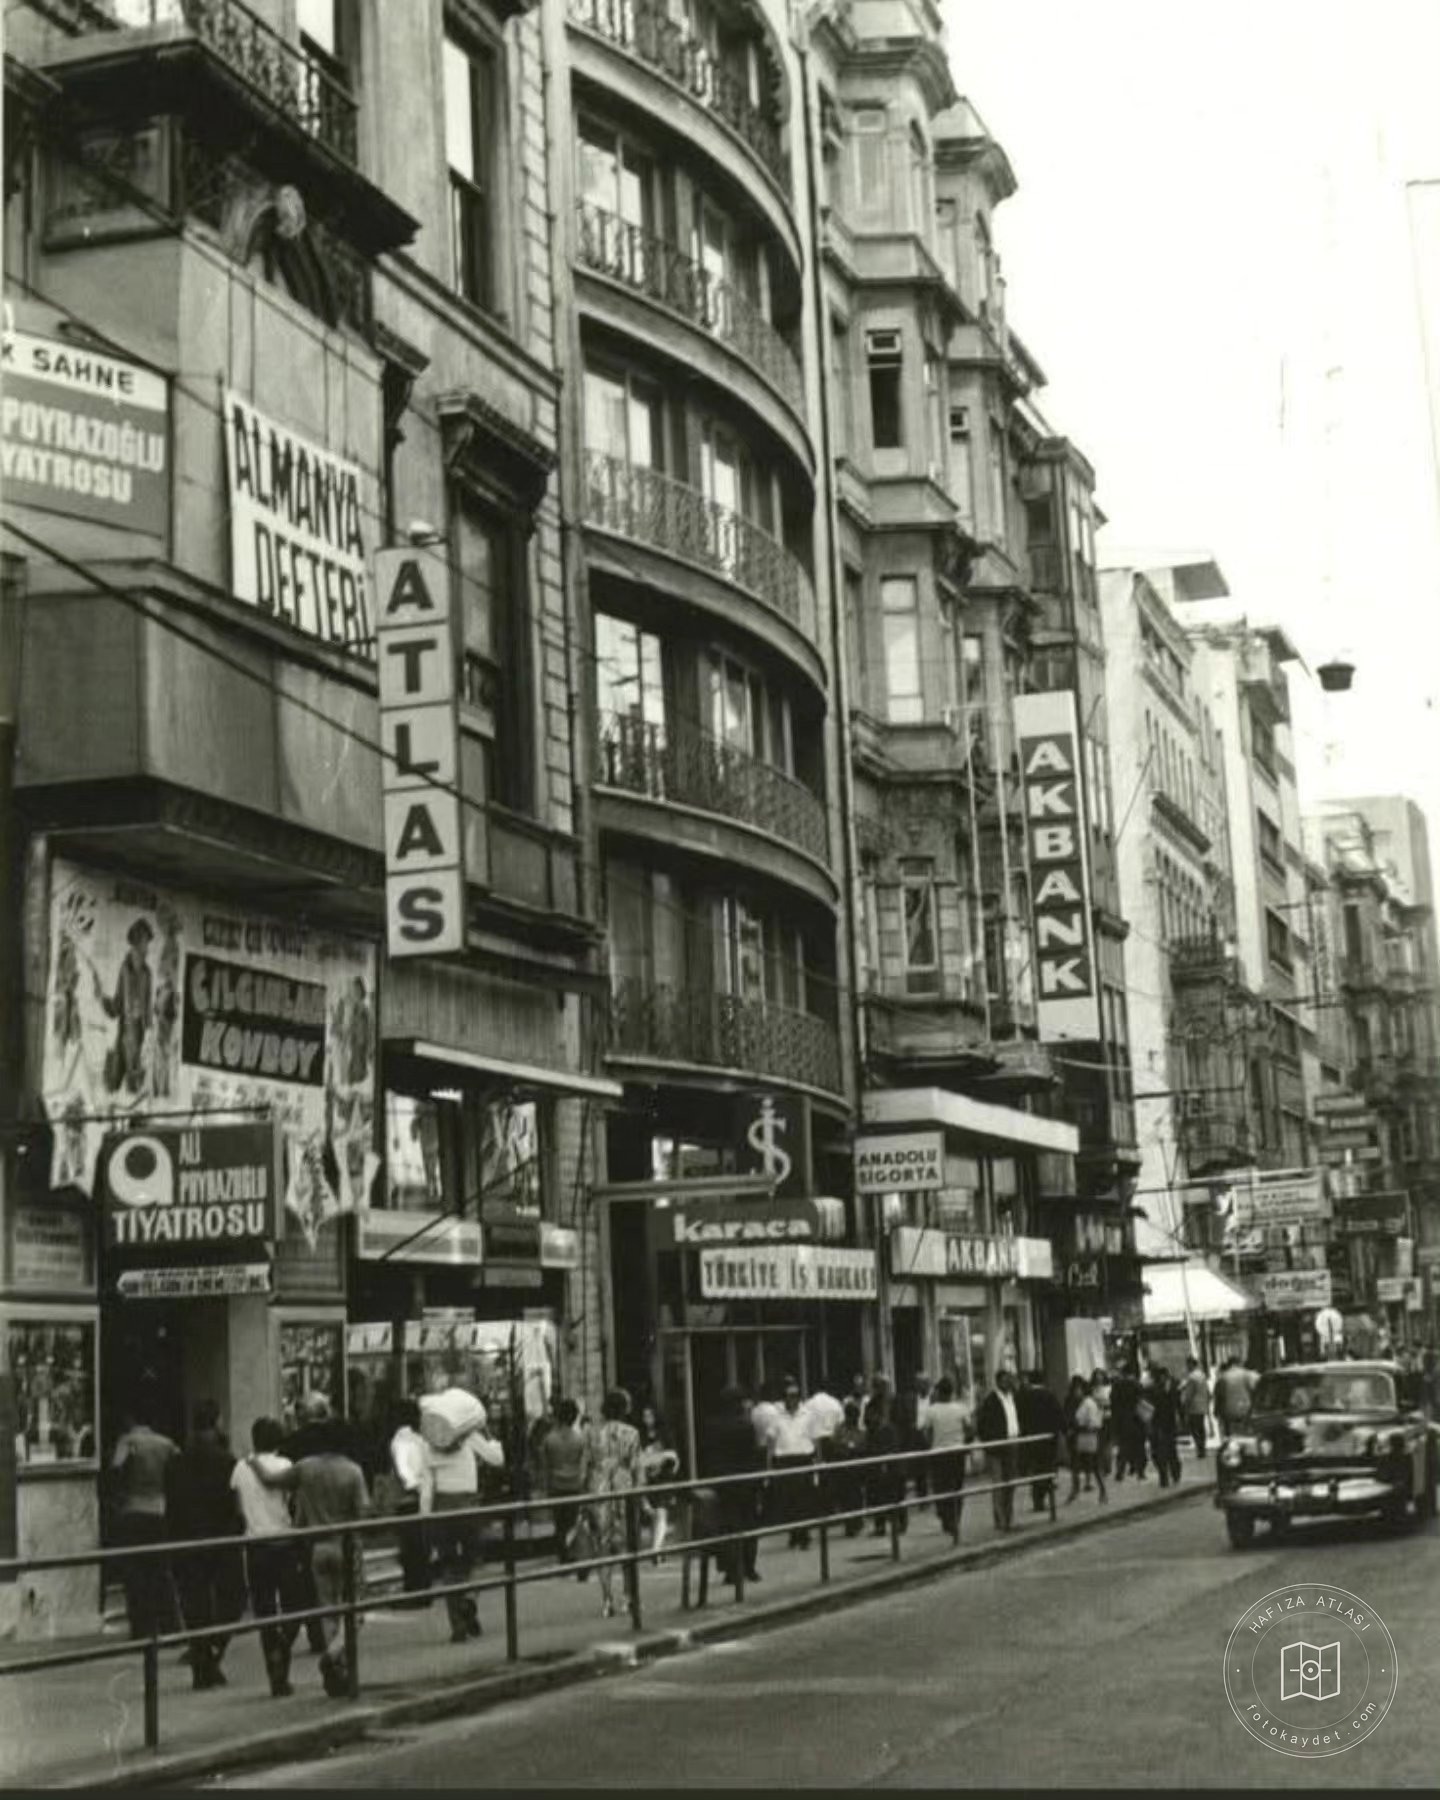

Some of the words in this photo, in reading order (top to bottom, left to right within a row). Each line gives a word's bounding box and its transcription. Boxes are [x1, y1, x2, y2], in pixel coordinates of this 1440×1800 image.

[32, 348, 135, 395] SAHNE
[233, 402, 365, 561] ALMANYA
[386, 559, 445, 942] ATLAS
[1026, 740, 1088, 994] AKBANK
[858, 1149, 938, 1168] ANADOLU
[673, 1213, 812, 1243] karaca
